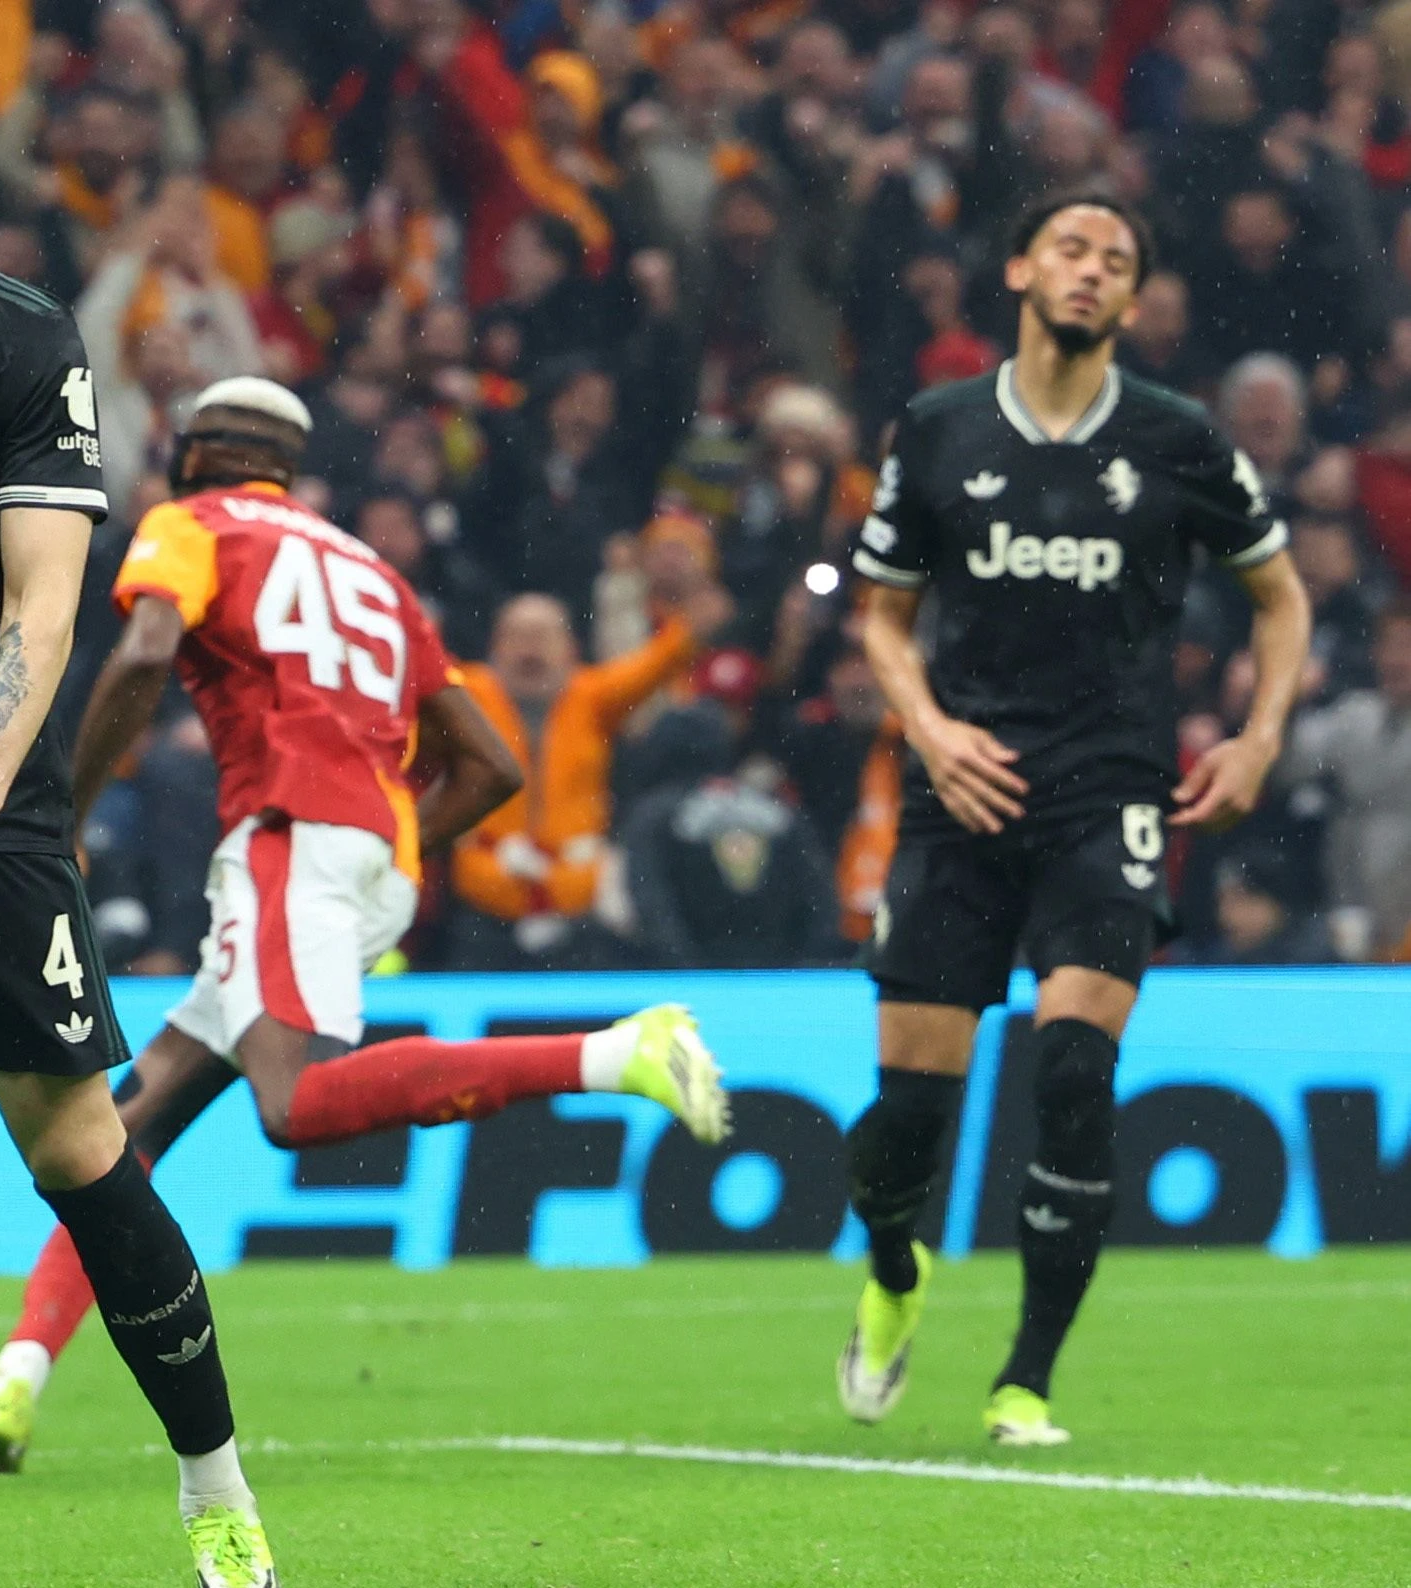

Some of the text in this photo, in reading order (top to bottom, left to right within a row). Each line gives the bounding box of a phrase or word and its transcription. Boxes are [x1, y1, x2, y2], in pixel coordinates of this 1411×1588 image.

[967, 522, 1123, 591] Jeep
[253, 534, 406, 716] 45
[42, 913, 85, 999] 4
